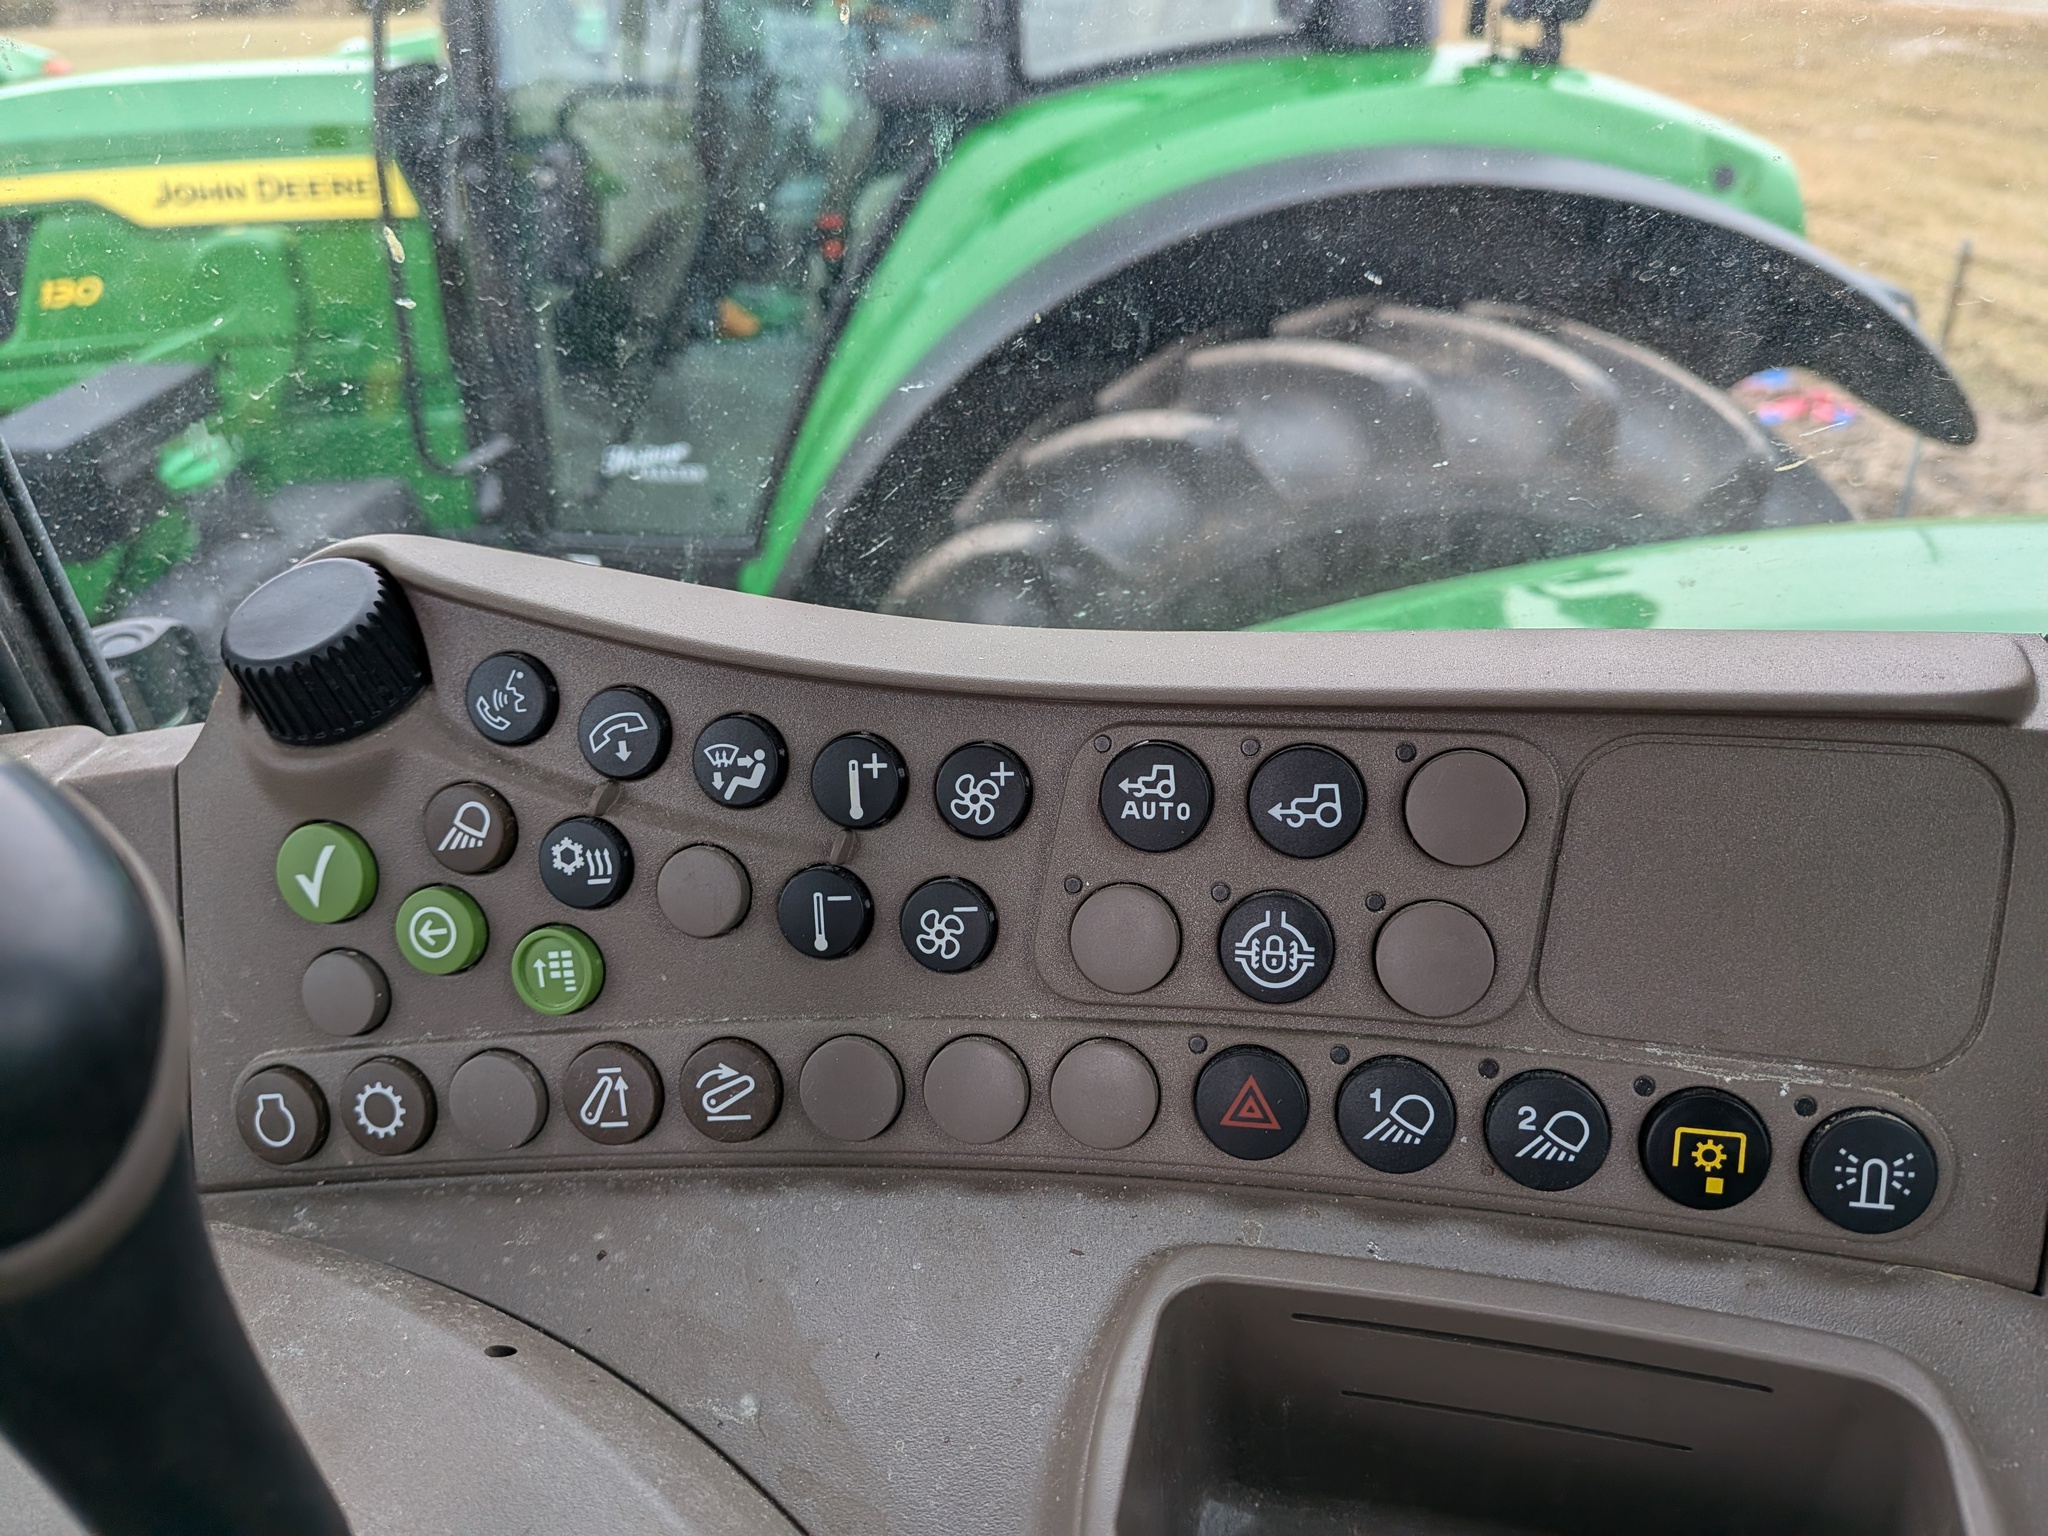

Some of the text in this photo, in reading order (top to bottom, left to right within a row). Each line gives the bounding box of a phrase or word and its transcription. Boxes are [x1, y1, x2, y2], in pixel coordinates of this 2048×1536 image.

[154, 177, 247, 208] JOHN
[1120, 800, 1191, 821] AUTO
[1369, 1087, 1382, 1113] 1
[1517, 1105, 1537, 1131] 2
